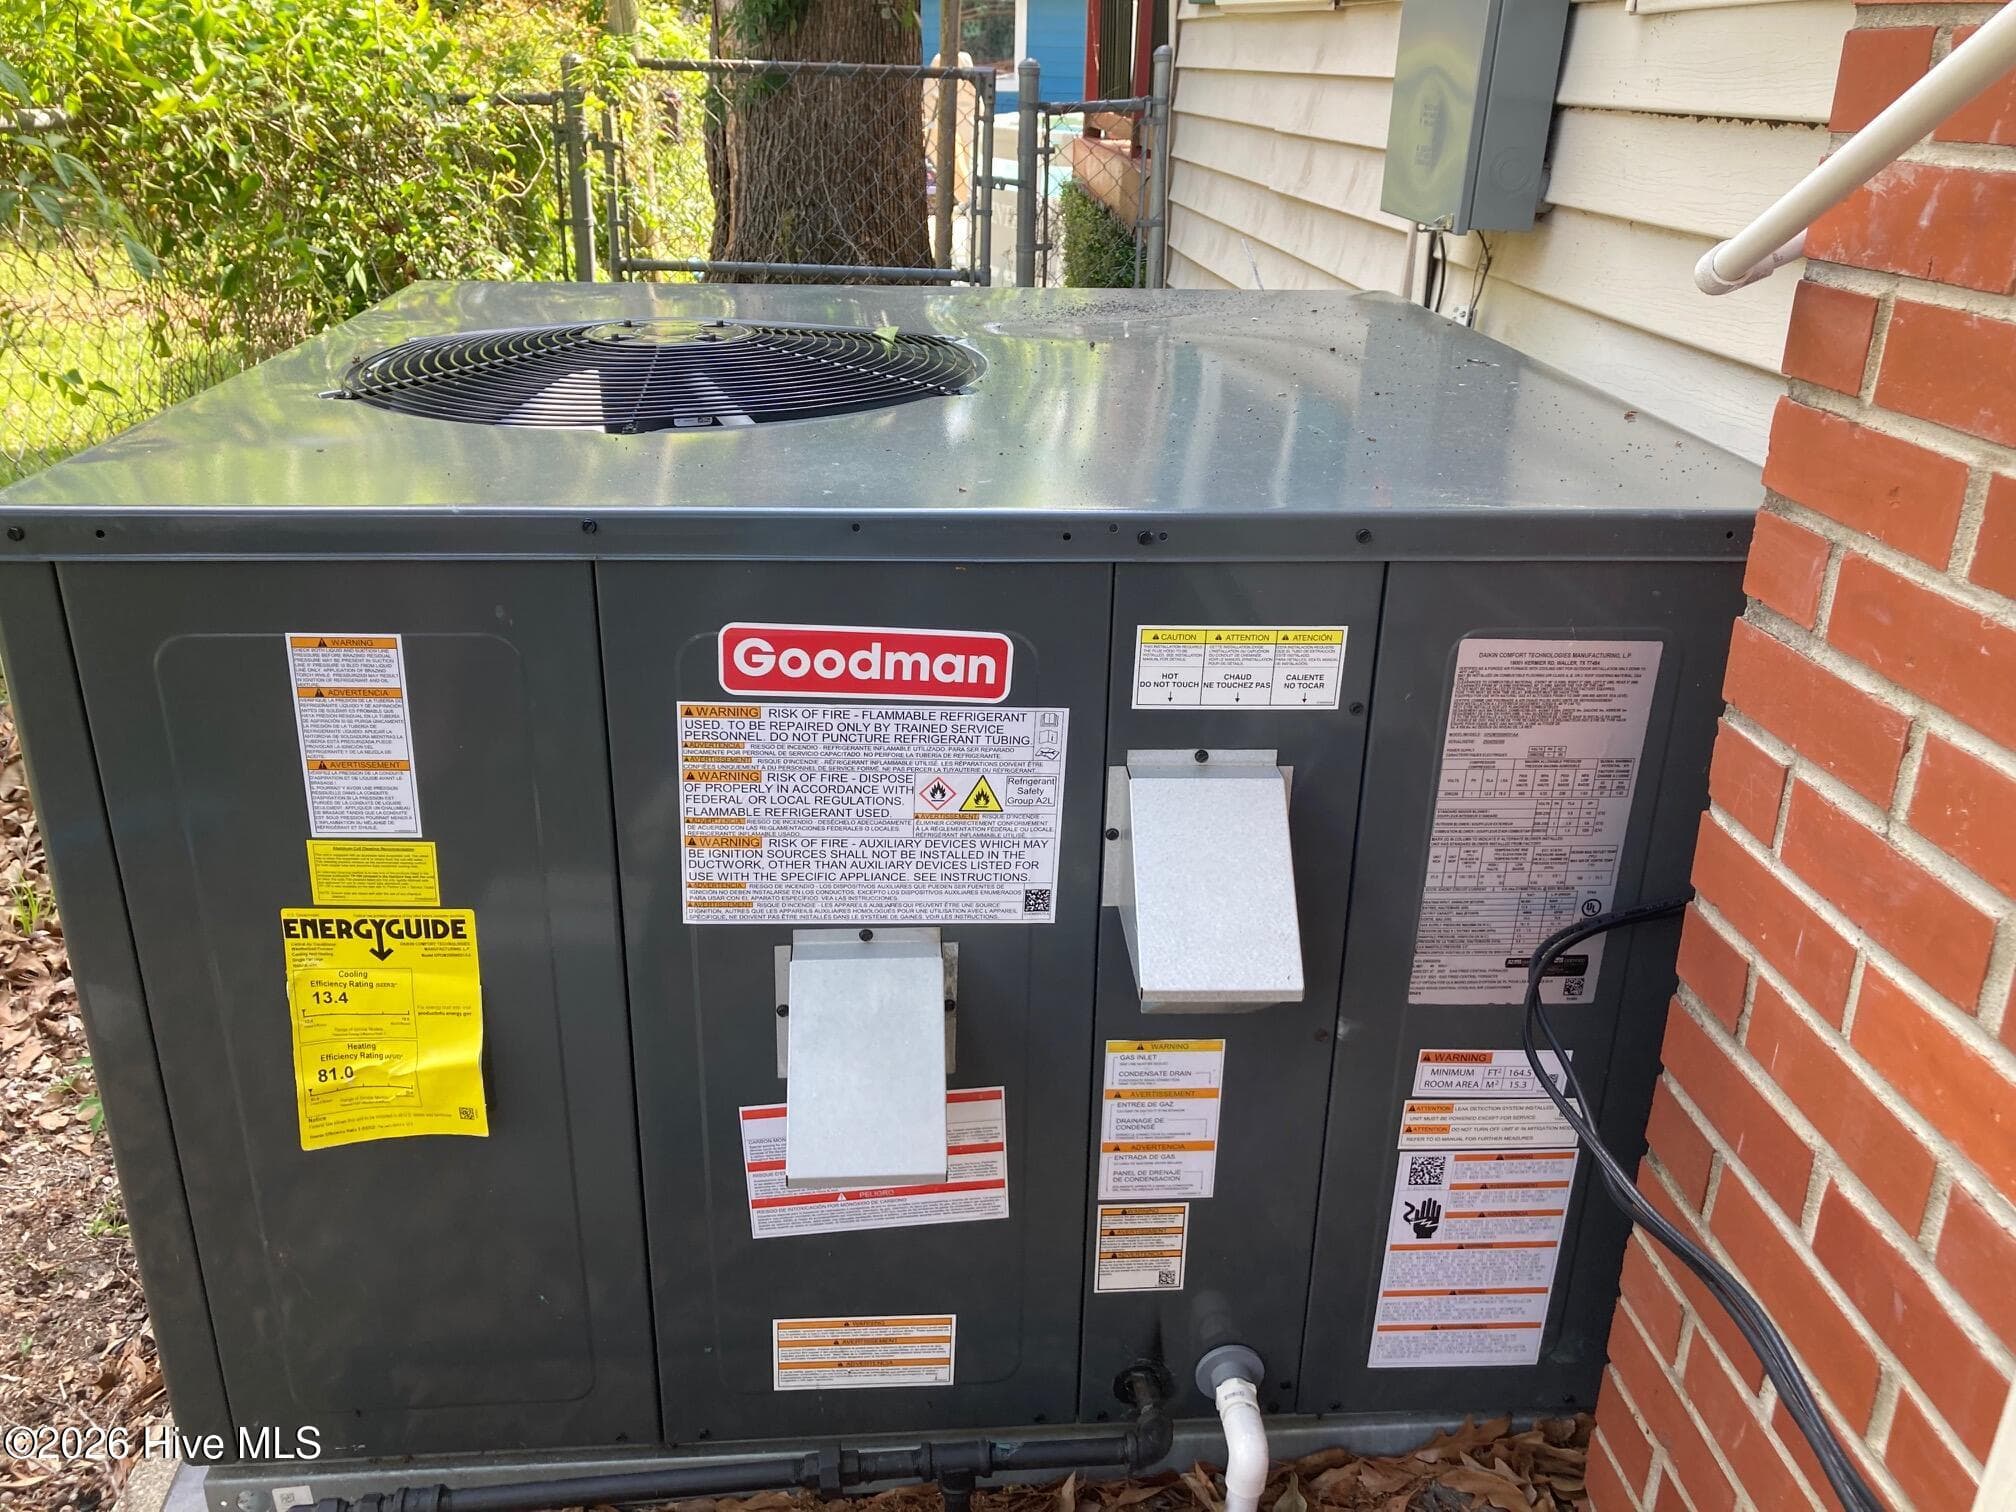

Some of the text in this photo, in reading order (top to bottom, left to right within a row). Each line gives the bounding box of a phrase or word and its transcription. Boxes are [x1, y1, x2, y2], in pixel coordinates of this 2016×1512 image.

[331, 639, 373, 647] WARNING
[733, 637, 996, 685] Goodman
[1223, 673, 1252, 681] CHAUD
[327, 689, 389, 697] ADVERTENCIA
[696, 708, 1028, 722] WARNING RISK OF FIRE FLAMMABLE REFRIGERANT
[685, 720, 1004, 734] USED. TO BE REPAIRED ONLY BY TRAINED SERVICE
[684, 731, 1033, 746] PERSONNEL. DO NOT PUNCTURE REFRIGERANT TUBING.
[330, 761, 400, 769] AVERTISSEMENT
[699, 772, 913, 784] WARNING RISK OF FIRE DISPOSE
[1008, 777, 1055, 787] Refrigerant
[684, 783, 914, 795] OF PROPERLY IN ACCORDANCE WITH
[1017, 787, 1044, 797] Safety
[685, 795, 904, 806] FEDERAL OR LOCAL REGULATIONS.
[1007, 796, 1053, 807] Group A2L
[685, 807, 892, 818] FLAMMABLE REFRIGERANT USED.
[700, 838, 1049, 849] WARNING RISK OF FIRE AUXILIARY DEVICES WHICH MAY
[688, 849, 1025, 860] BE IGNITION SOURCES SHALL NOT BE INSTALLED IN THE
[688, 860, 1039, 871] DUCTWORK, OTHER THAN AUXILIARY DEVICES LISTED FOR
[688, 872, 1030, 882] USE WITH THE SPECIFIC APPLIANCE. SEE INSTRUCTIONS.
[283, 918, 467, 949] ENERGYGUIDE
[338, 970, 368, 978] Cooling
[310, 980, 374, 989] Efficiency Rating
[312, 991, 348, 1005] 13.4
[320, 1052, 384, 1062] Efficiency Rating
[1434, 1054, 1487, 1062] WARNING
[318, 1066, 354, 1083] 81.0
[1509, 1069, 1532, 1077] 164.5
[859, 1189, 895, 1199] PELIGRO
